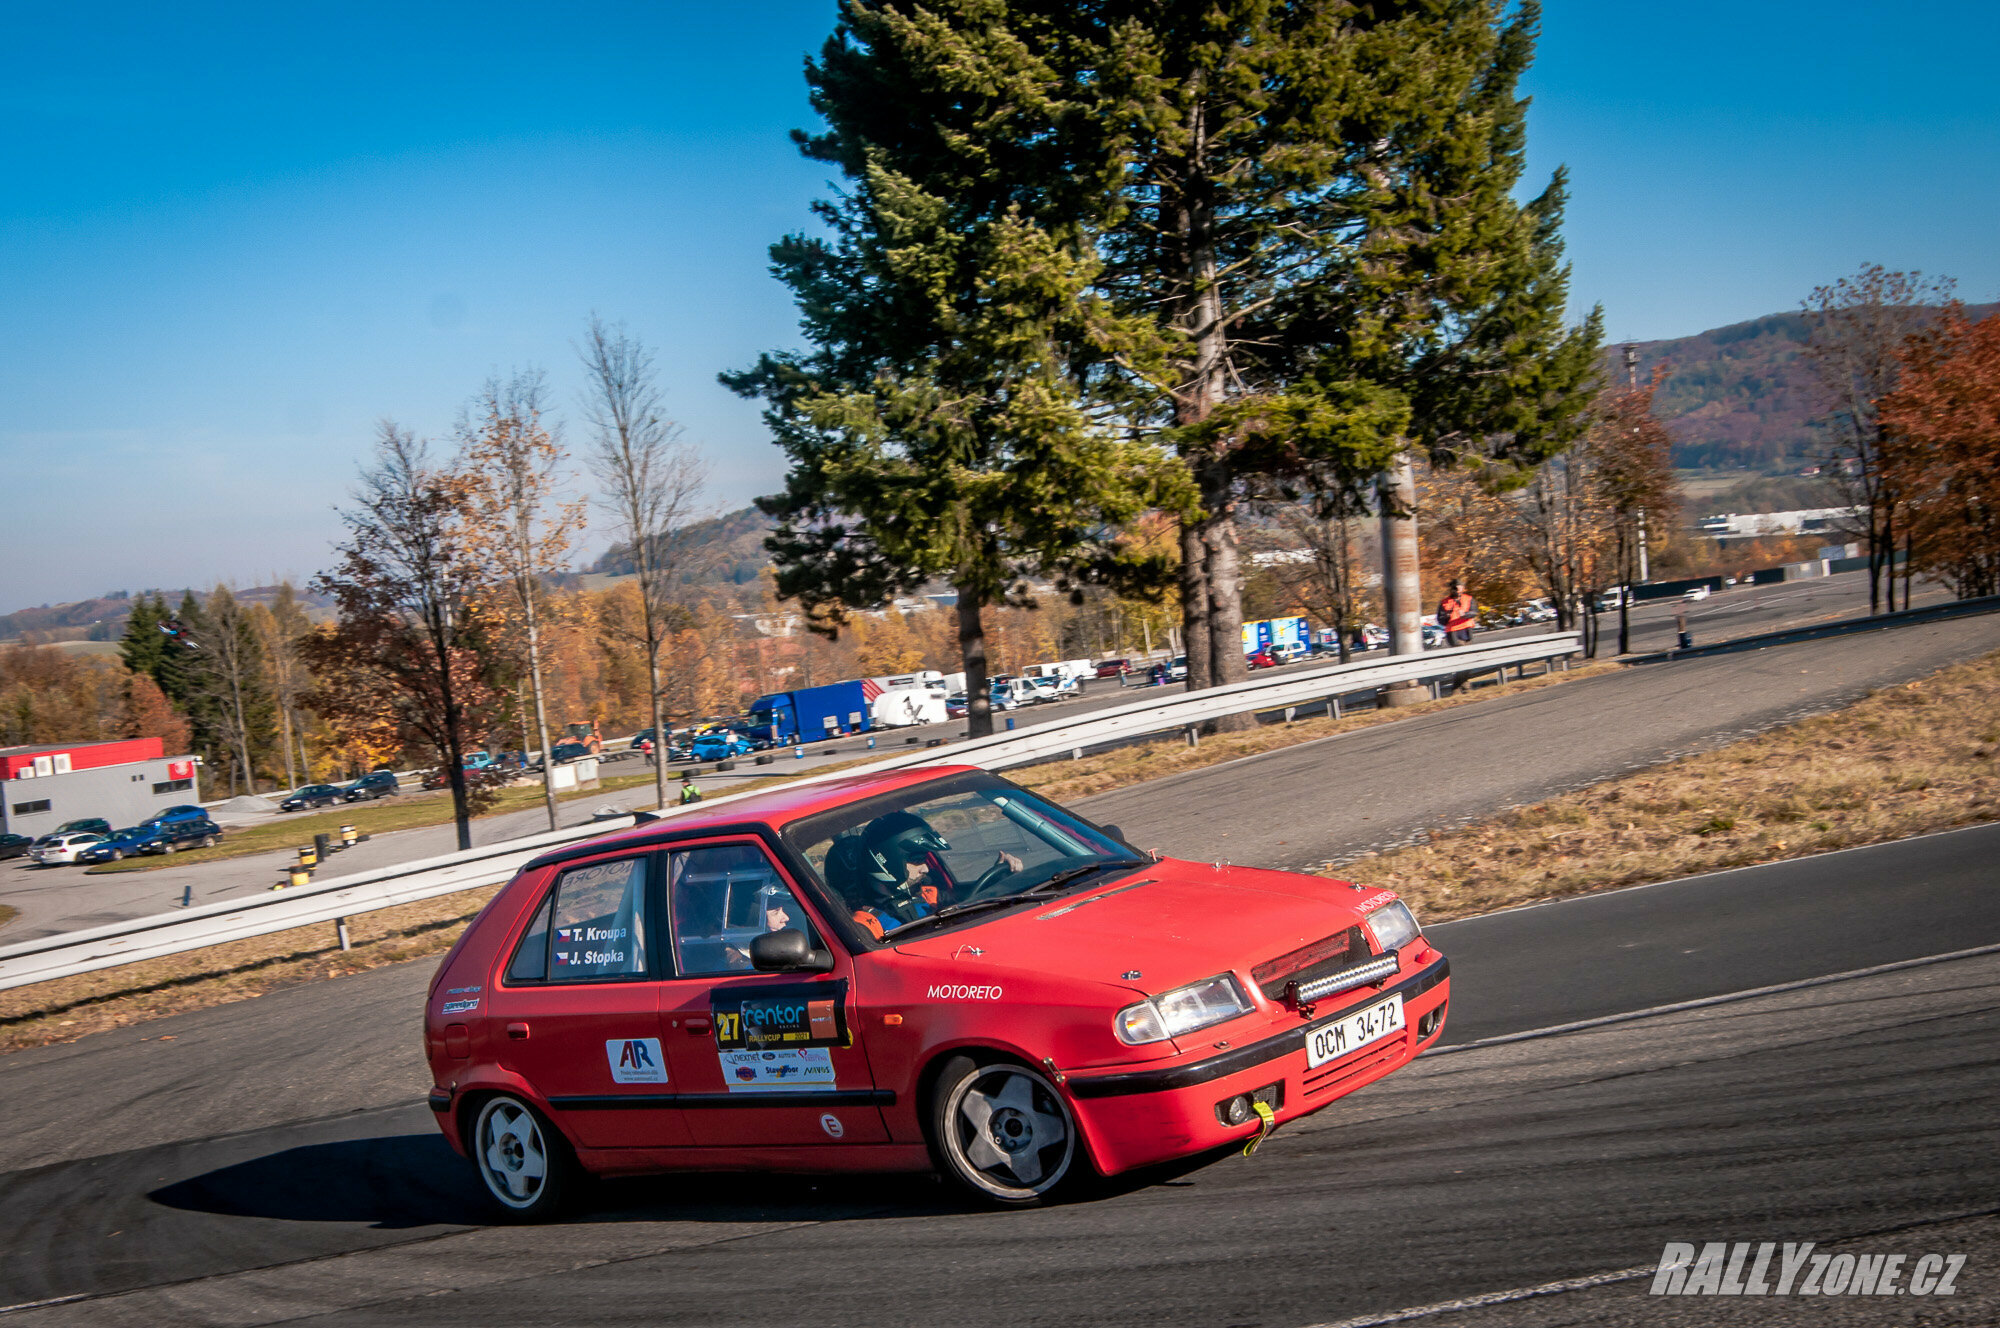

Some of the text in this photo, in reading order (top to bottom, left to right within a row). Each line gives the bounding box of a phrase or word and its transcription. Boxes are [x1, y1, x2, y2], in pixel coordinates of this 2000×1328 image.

[573, 927, 627, 941] T. Kroupa
[570, 949, 624, 966] J. Stopka
[927, 984, 1003, 1000] MOTORETO
[745, 1004, 805, 1026] rentor
[1356, 1002, 1397, 1041] 34-72
[717, 1013, 739, 1041] 27
[748, 1033, 780, 1042] RALLYCUP
[619, 1040, 655, 1069] AR
[734, 1052, 760, 1062] nexnet
[824, 1118, 840, 1133] E
